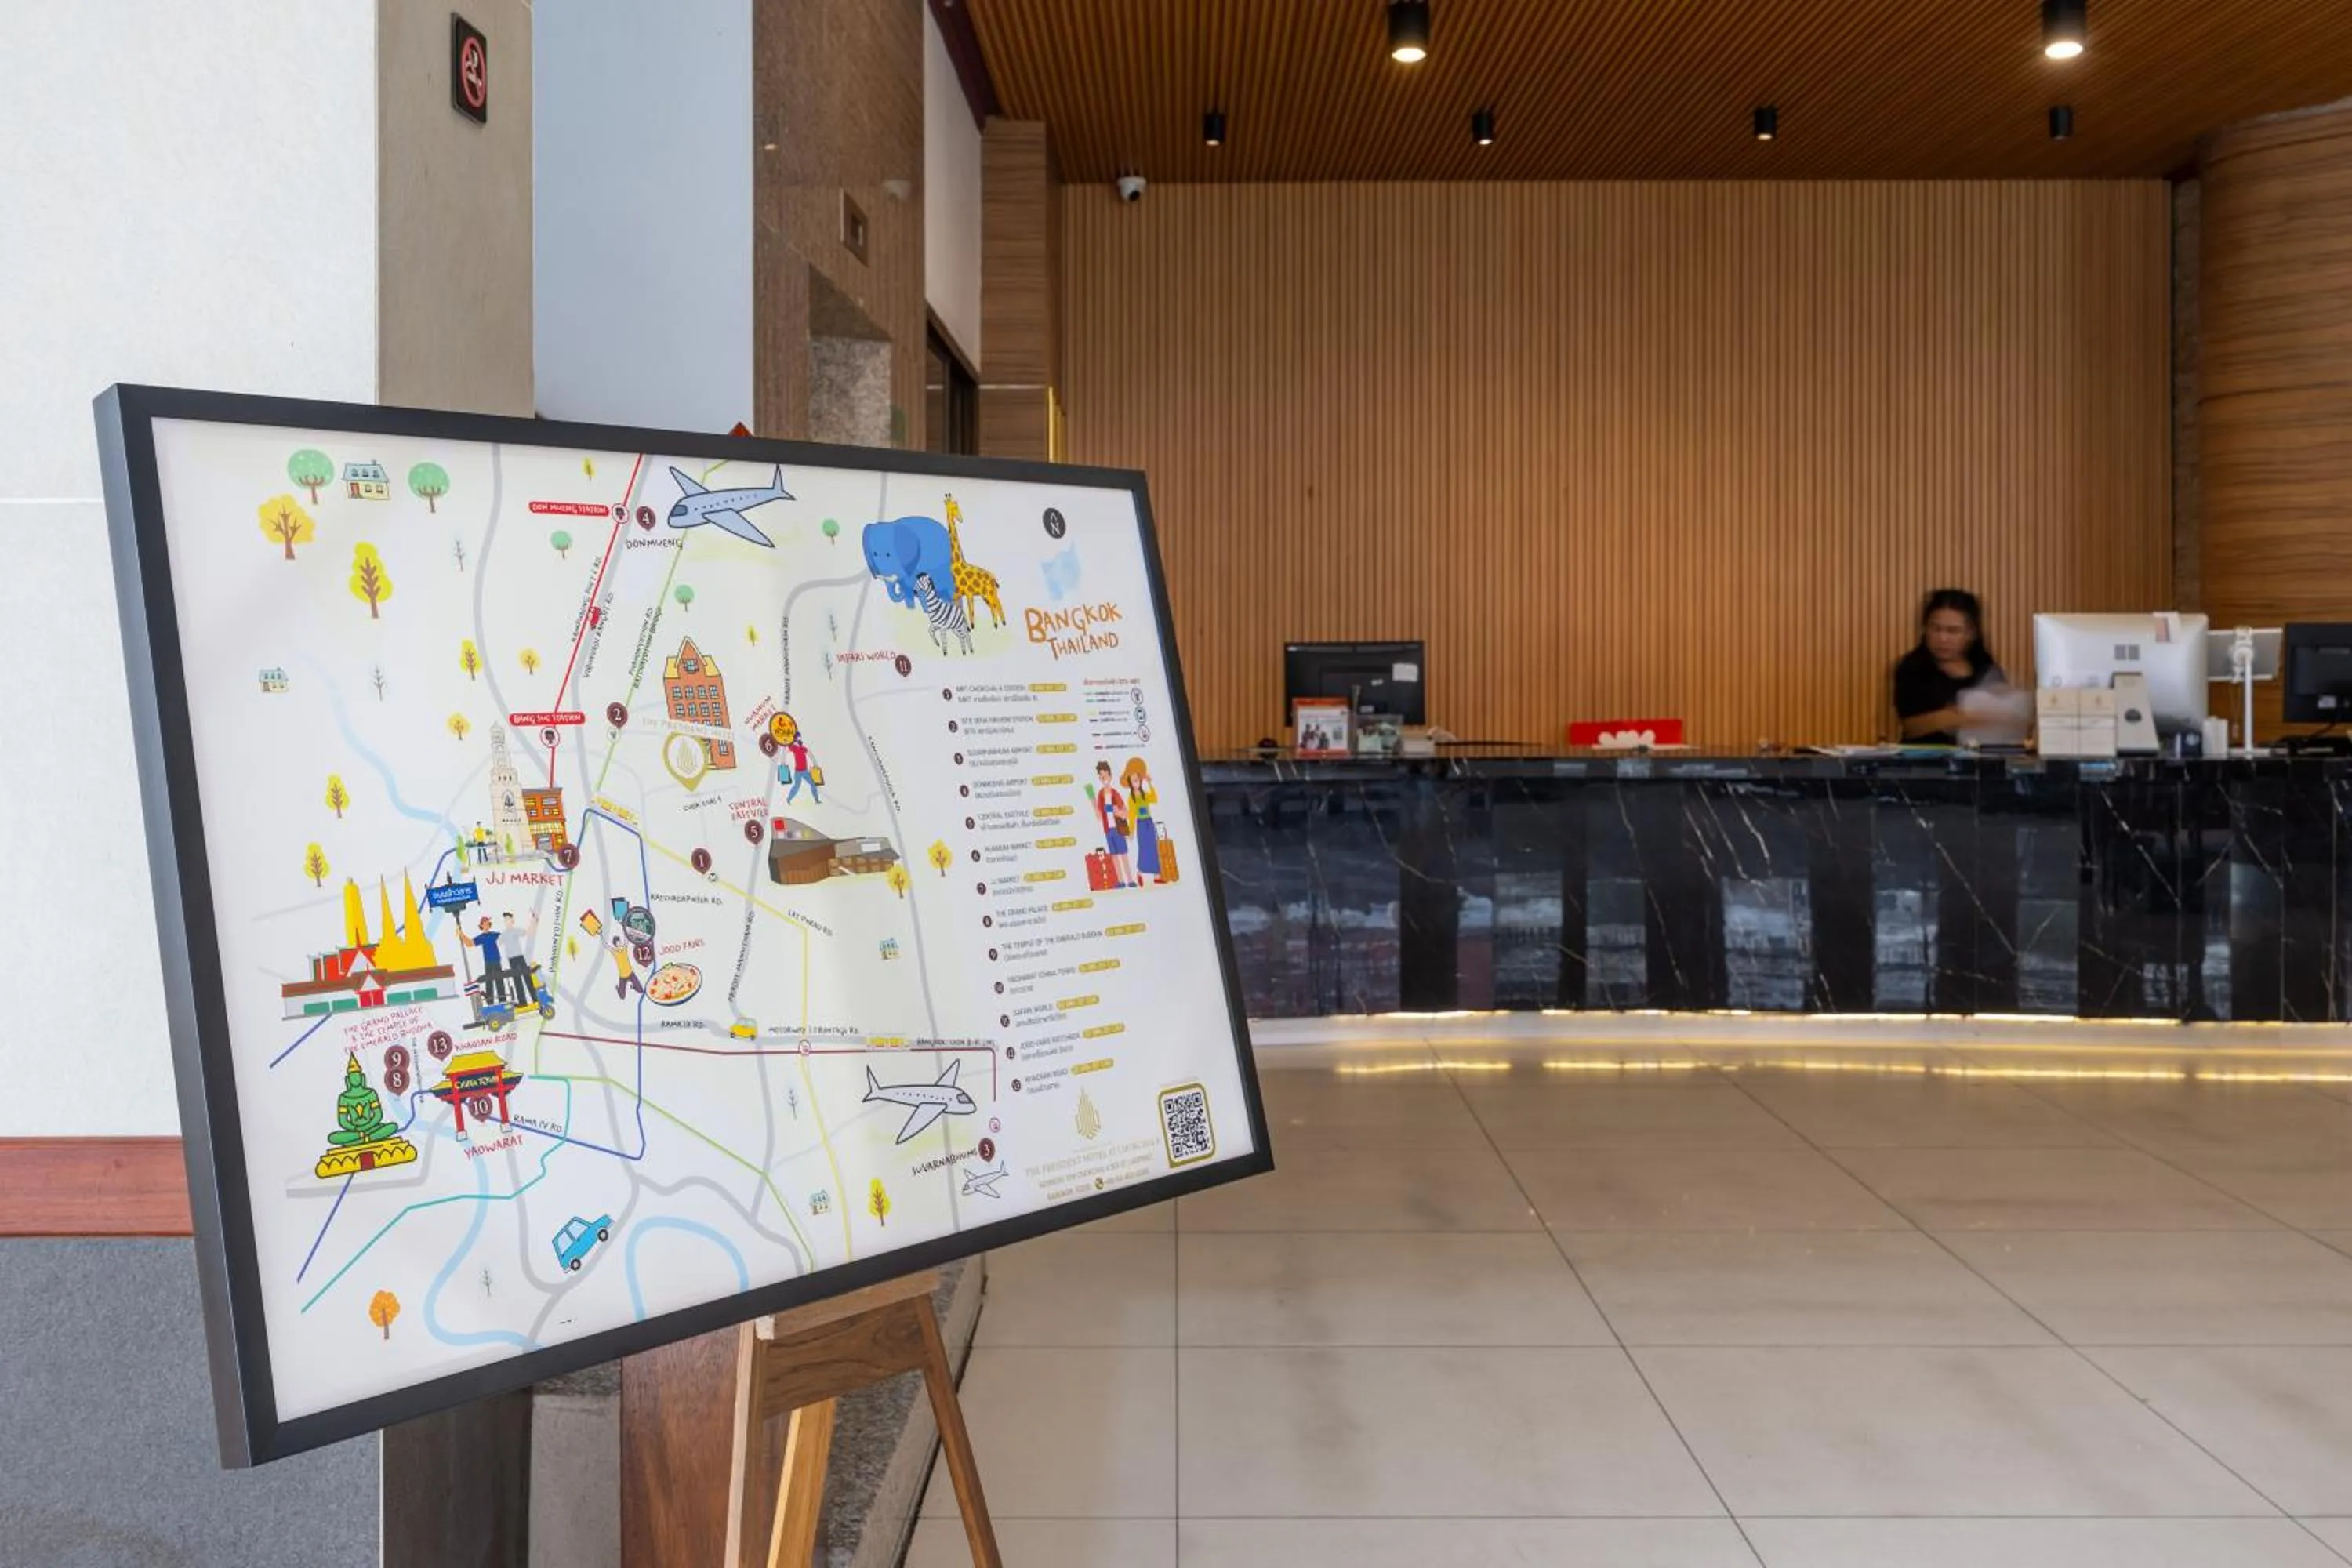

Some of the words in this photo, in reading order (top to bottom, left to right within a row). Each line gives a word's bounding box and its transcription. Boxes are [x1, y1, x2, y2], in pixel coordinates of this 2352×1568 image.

[642, 512, 649, 524] 4
[1025, 602, 1123, 643] BANGKOK
[1047, 632, 1119, 661] THAILAND
[899, 659, 909, 673] 11
[614, 708, 622, 720] 2
[765, 739, 773, 752] 6
[750, 825, 758, 838] 5
[486, 871, 506, 885] JJ
[511, 873, 564, 887] MARKET
[637, 946, 652, 960] 12
[433, 1038, 448, 1053] 13
[392, 1051, 401, 1067] 9
[393, 1073, 401, 1087] 8
[473, 1099, 488, 1116] 10
[464, 1134, 523, 1160] YAOWARAT
